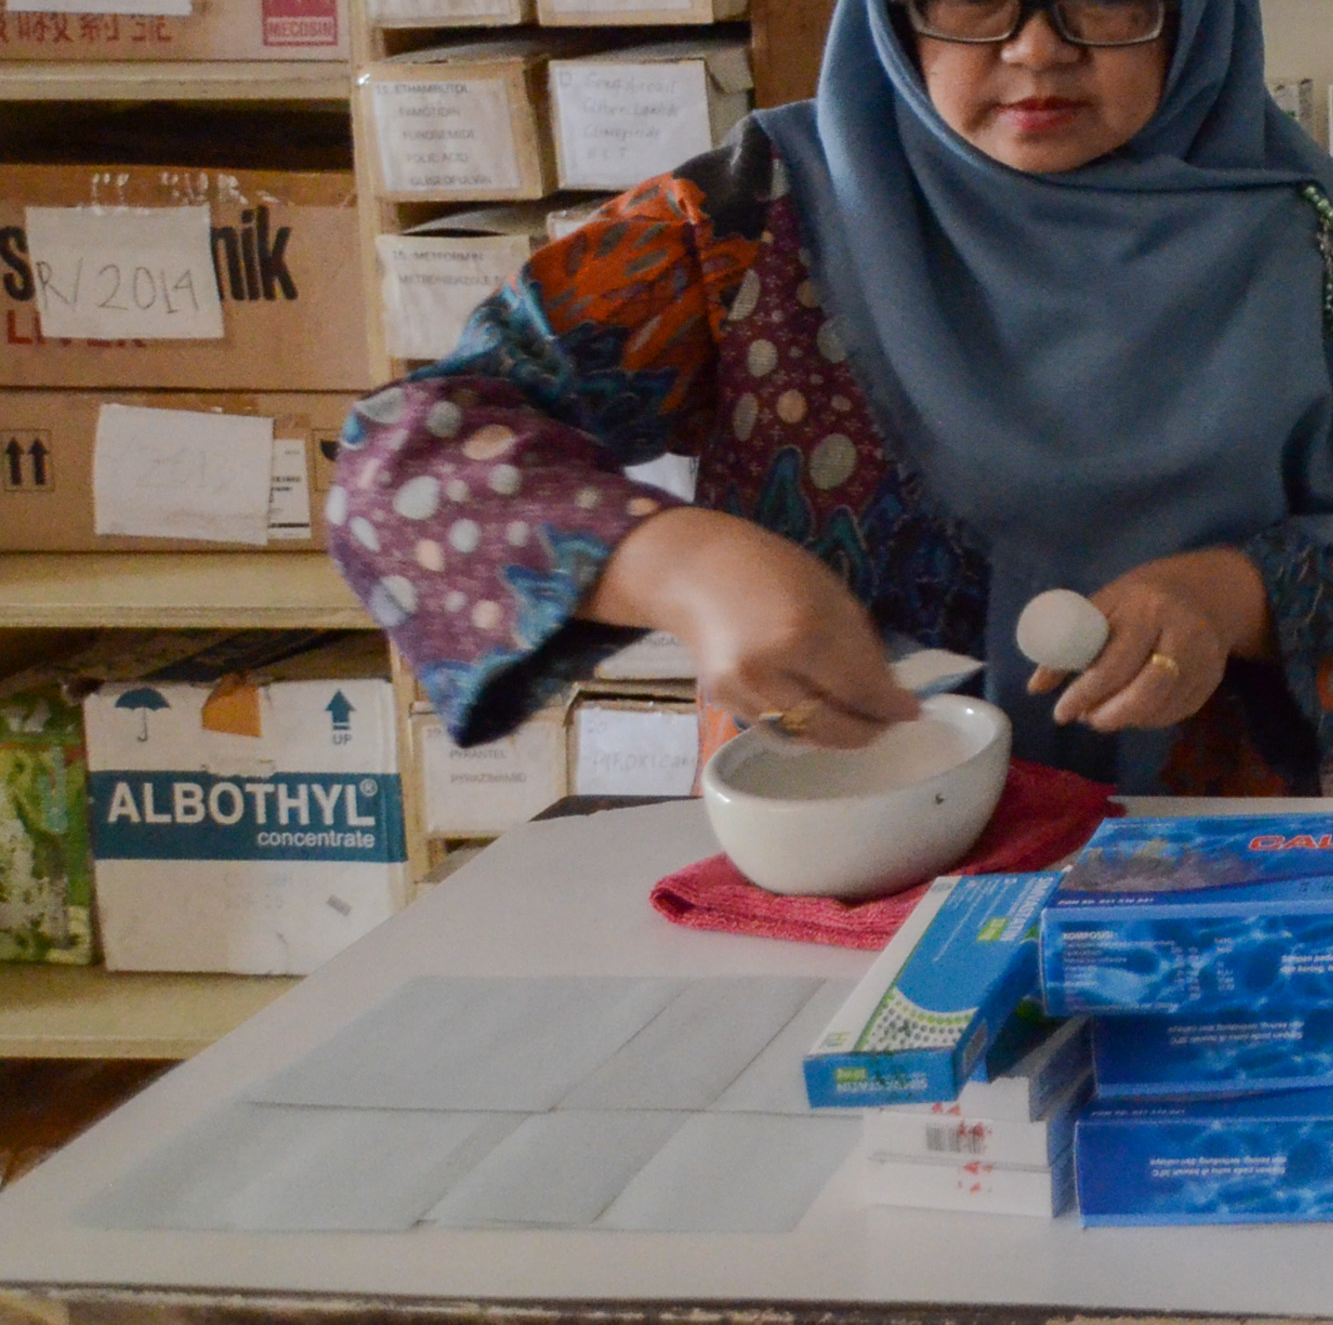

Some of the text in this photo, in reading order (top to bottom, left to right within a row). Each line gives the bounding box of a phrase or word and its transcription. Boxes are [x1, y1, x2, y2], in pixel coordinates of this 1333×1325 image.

[331, 732, 352, 745] UP
[107, 781, 376, 826] ALBOTHYL
[256, 828, 376, 850] concentrate
